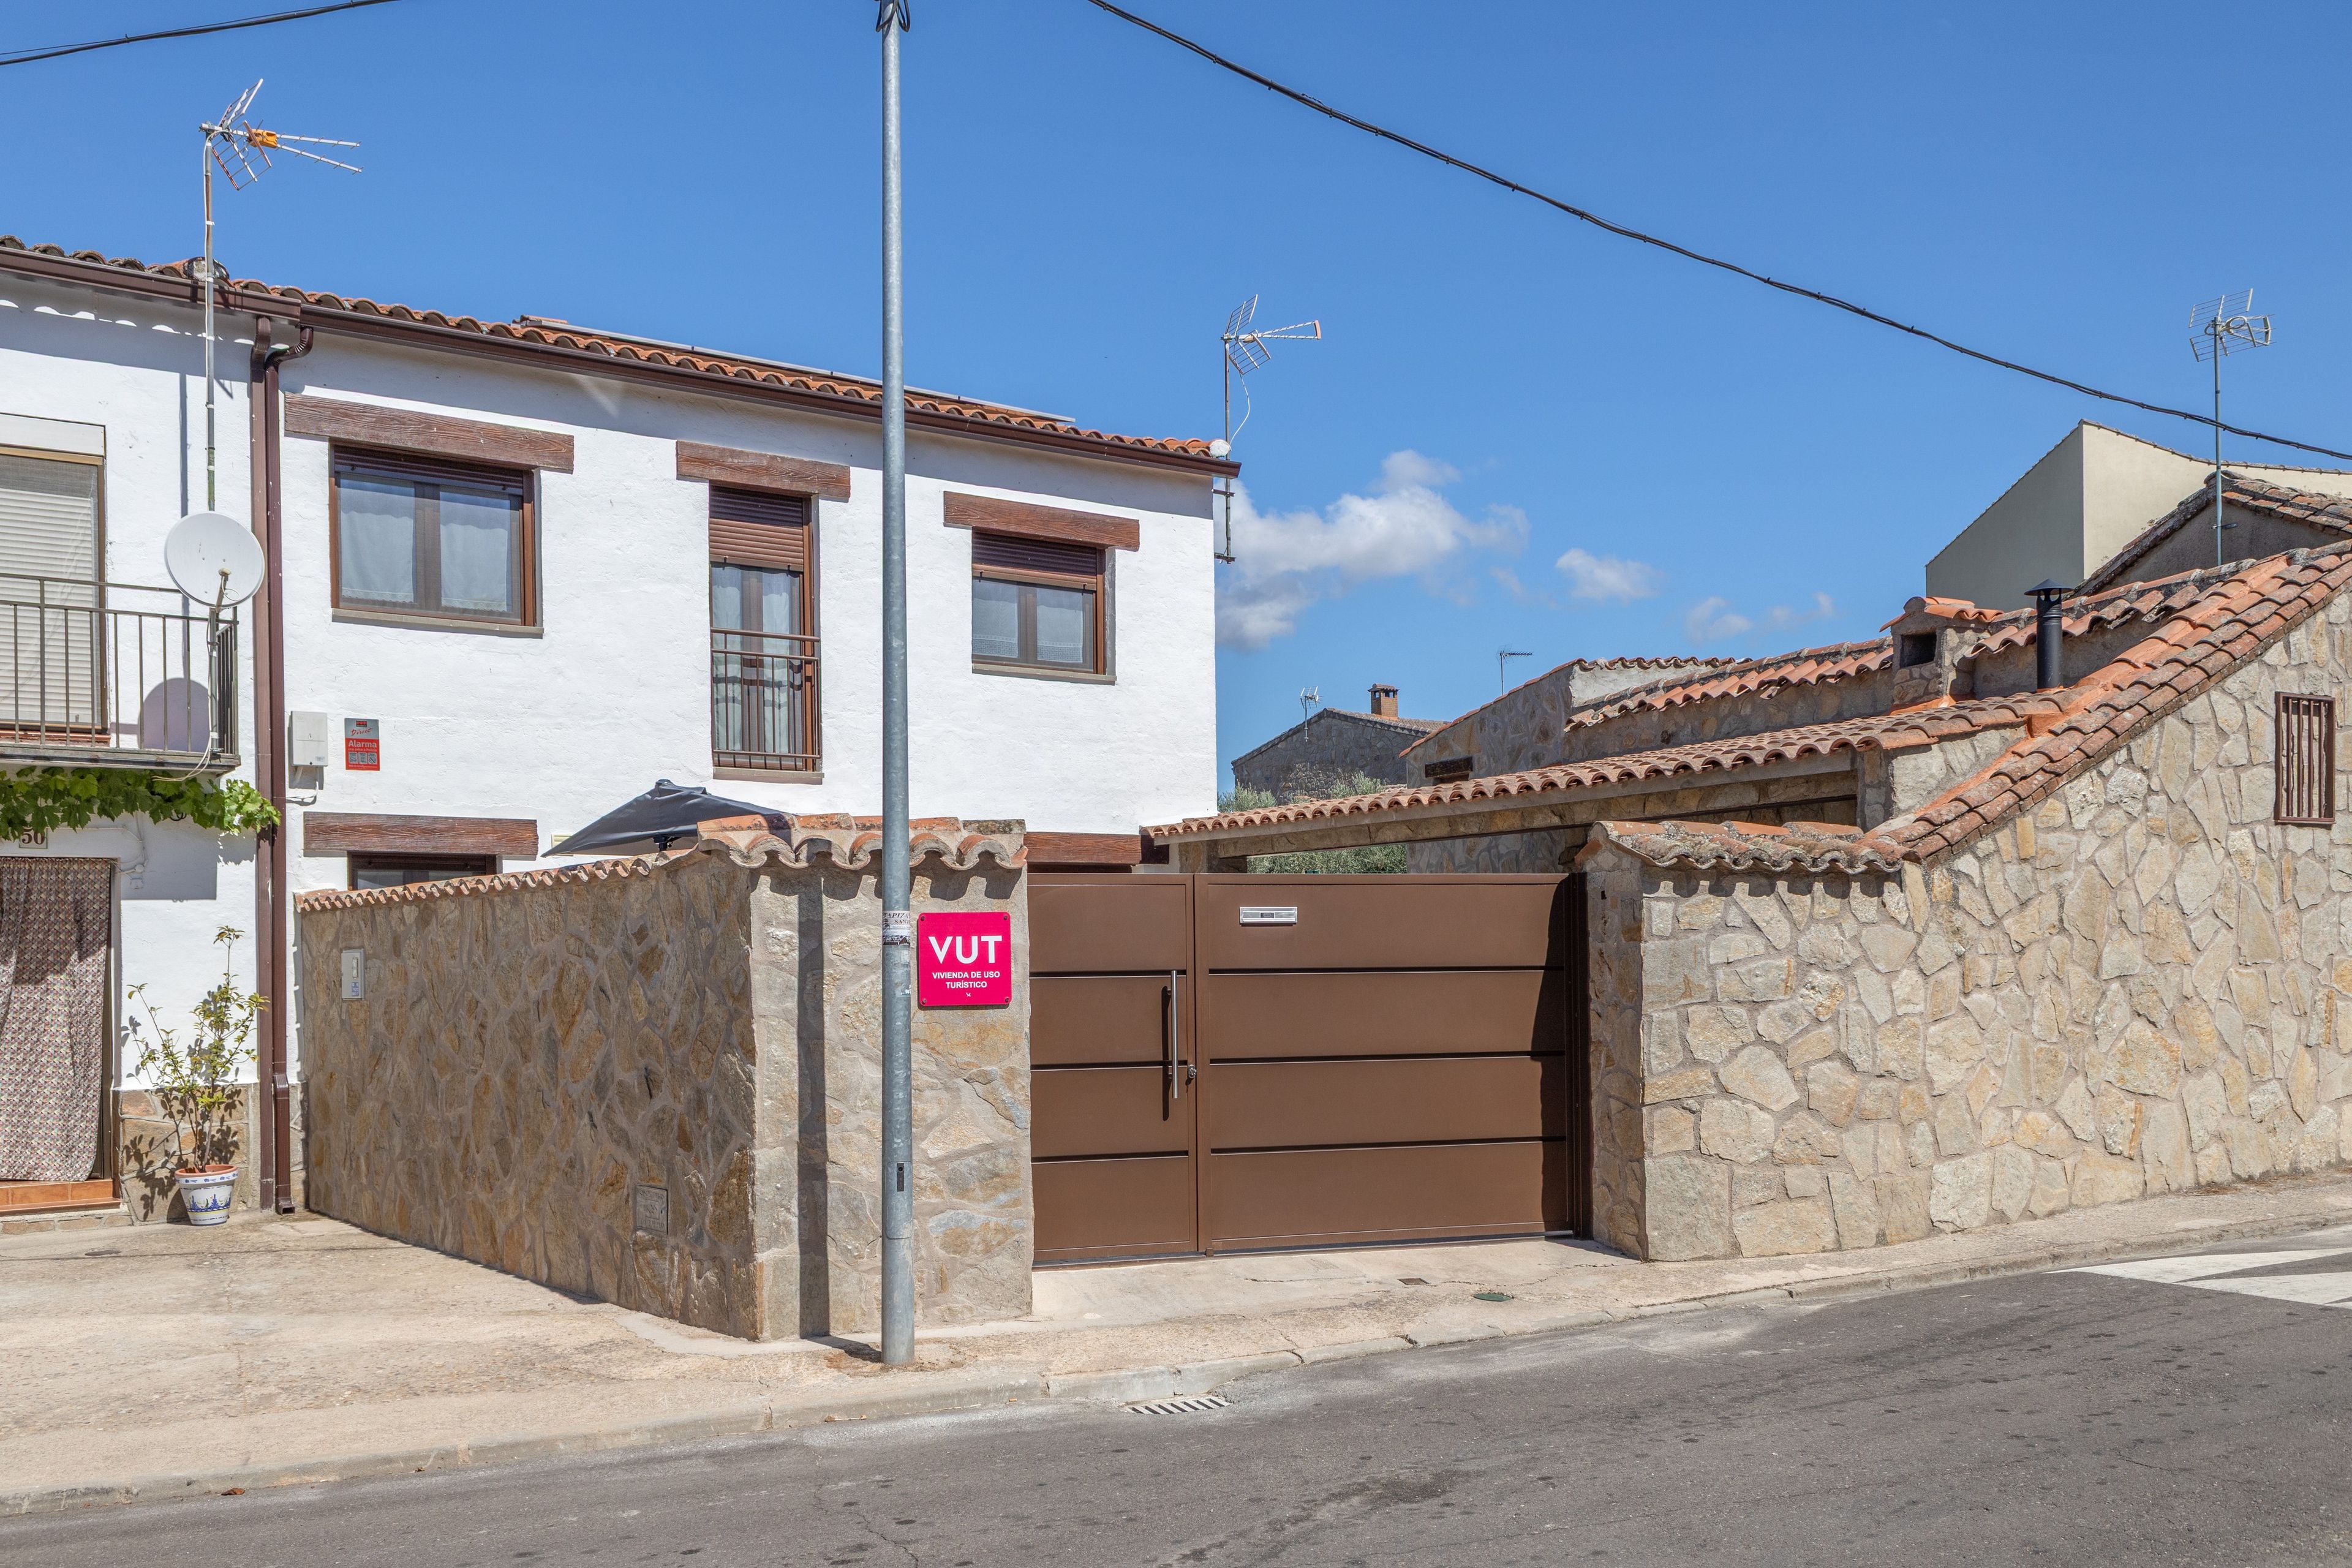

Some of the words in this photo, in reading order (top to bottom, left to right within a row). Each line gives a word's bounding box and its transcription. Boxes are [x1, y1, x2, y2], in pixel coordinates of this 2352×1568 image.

[21, 829, 45, 845] 50
[928, 935, 1002, 964] VUT
[946, 979, 987, 989] TURÍSTICO
